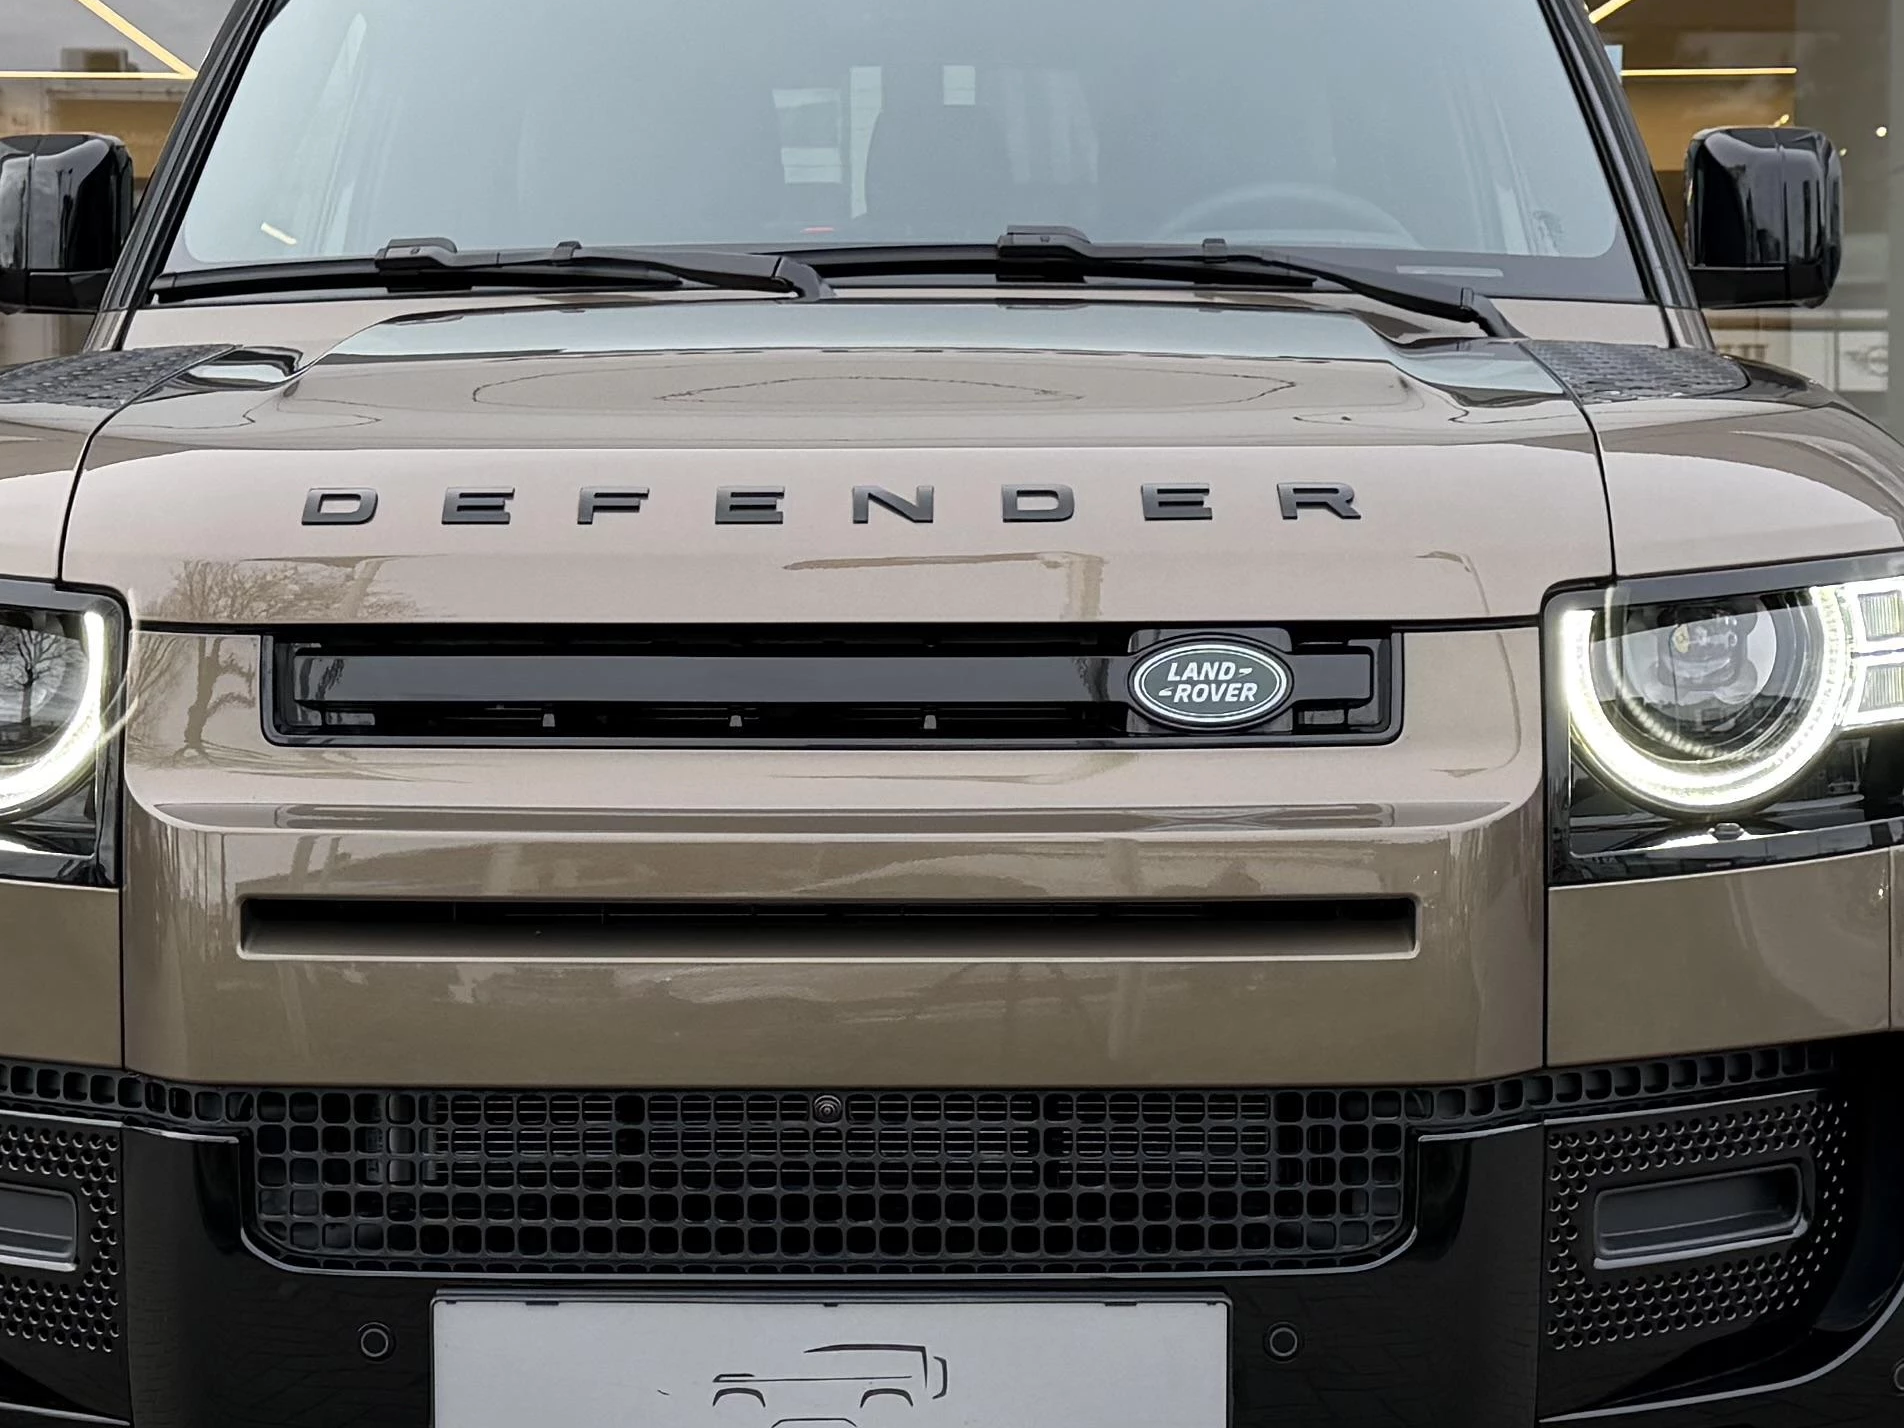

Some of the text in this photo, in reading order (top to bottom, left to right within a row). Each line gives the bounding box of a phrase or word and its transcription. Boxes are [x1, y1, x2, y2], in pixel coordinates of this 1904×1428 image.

[301, 483, 1362, 527] DEFENDER
[1167, 661, 1235, 681] LAND
[1173, 682, 1258, 703] ROVER
